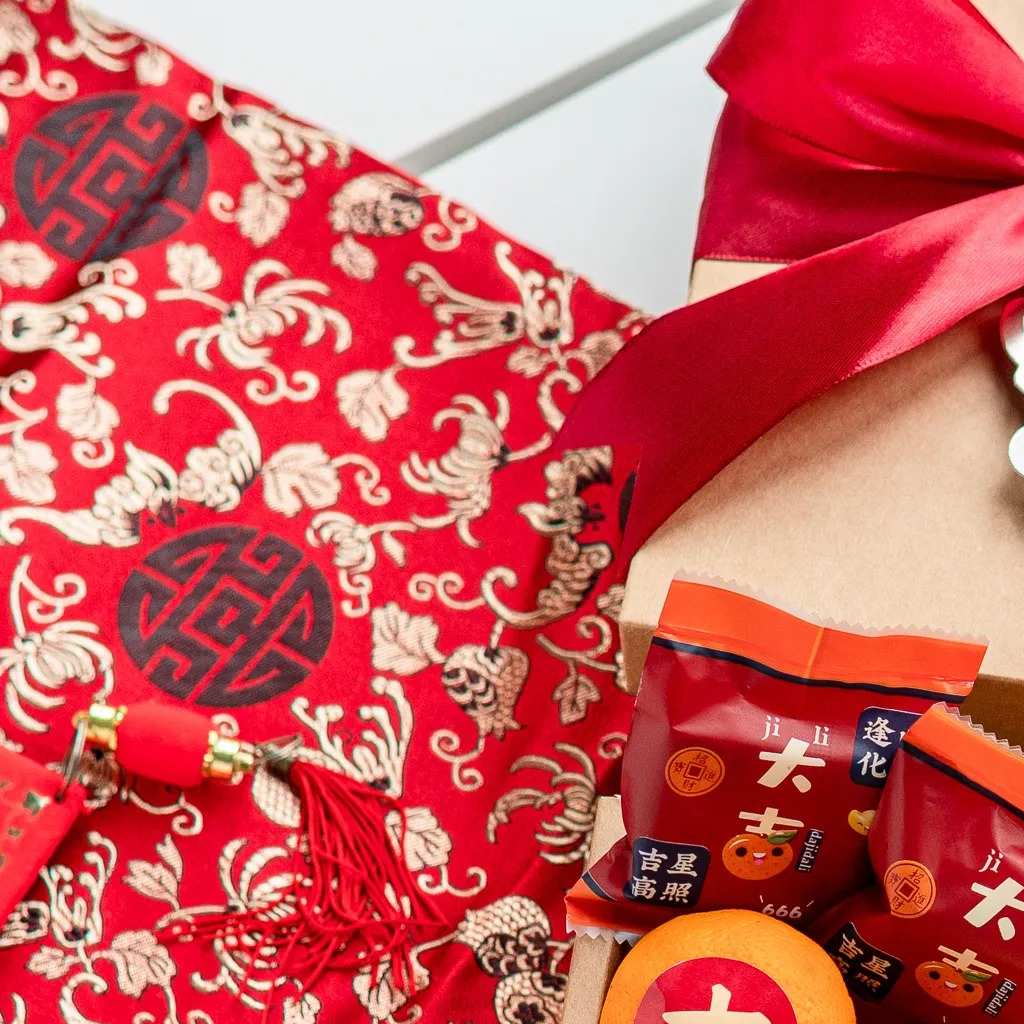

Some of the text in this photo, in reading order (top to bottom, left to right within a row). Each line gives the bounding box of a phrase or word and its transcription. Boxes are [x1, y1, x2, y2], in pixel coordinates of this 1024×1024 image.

[761, 715, 780, 740] ji
[814, 725, 830, 746] li
[638, 847, 698, 878] 吉星
[797, 829, 822, 872] dajidali
[979, 848, 1004, 873] ji
[762, 903, 802, 919] 666
